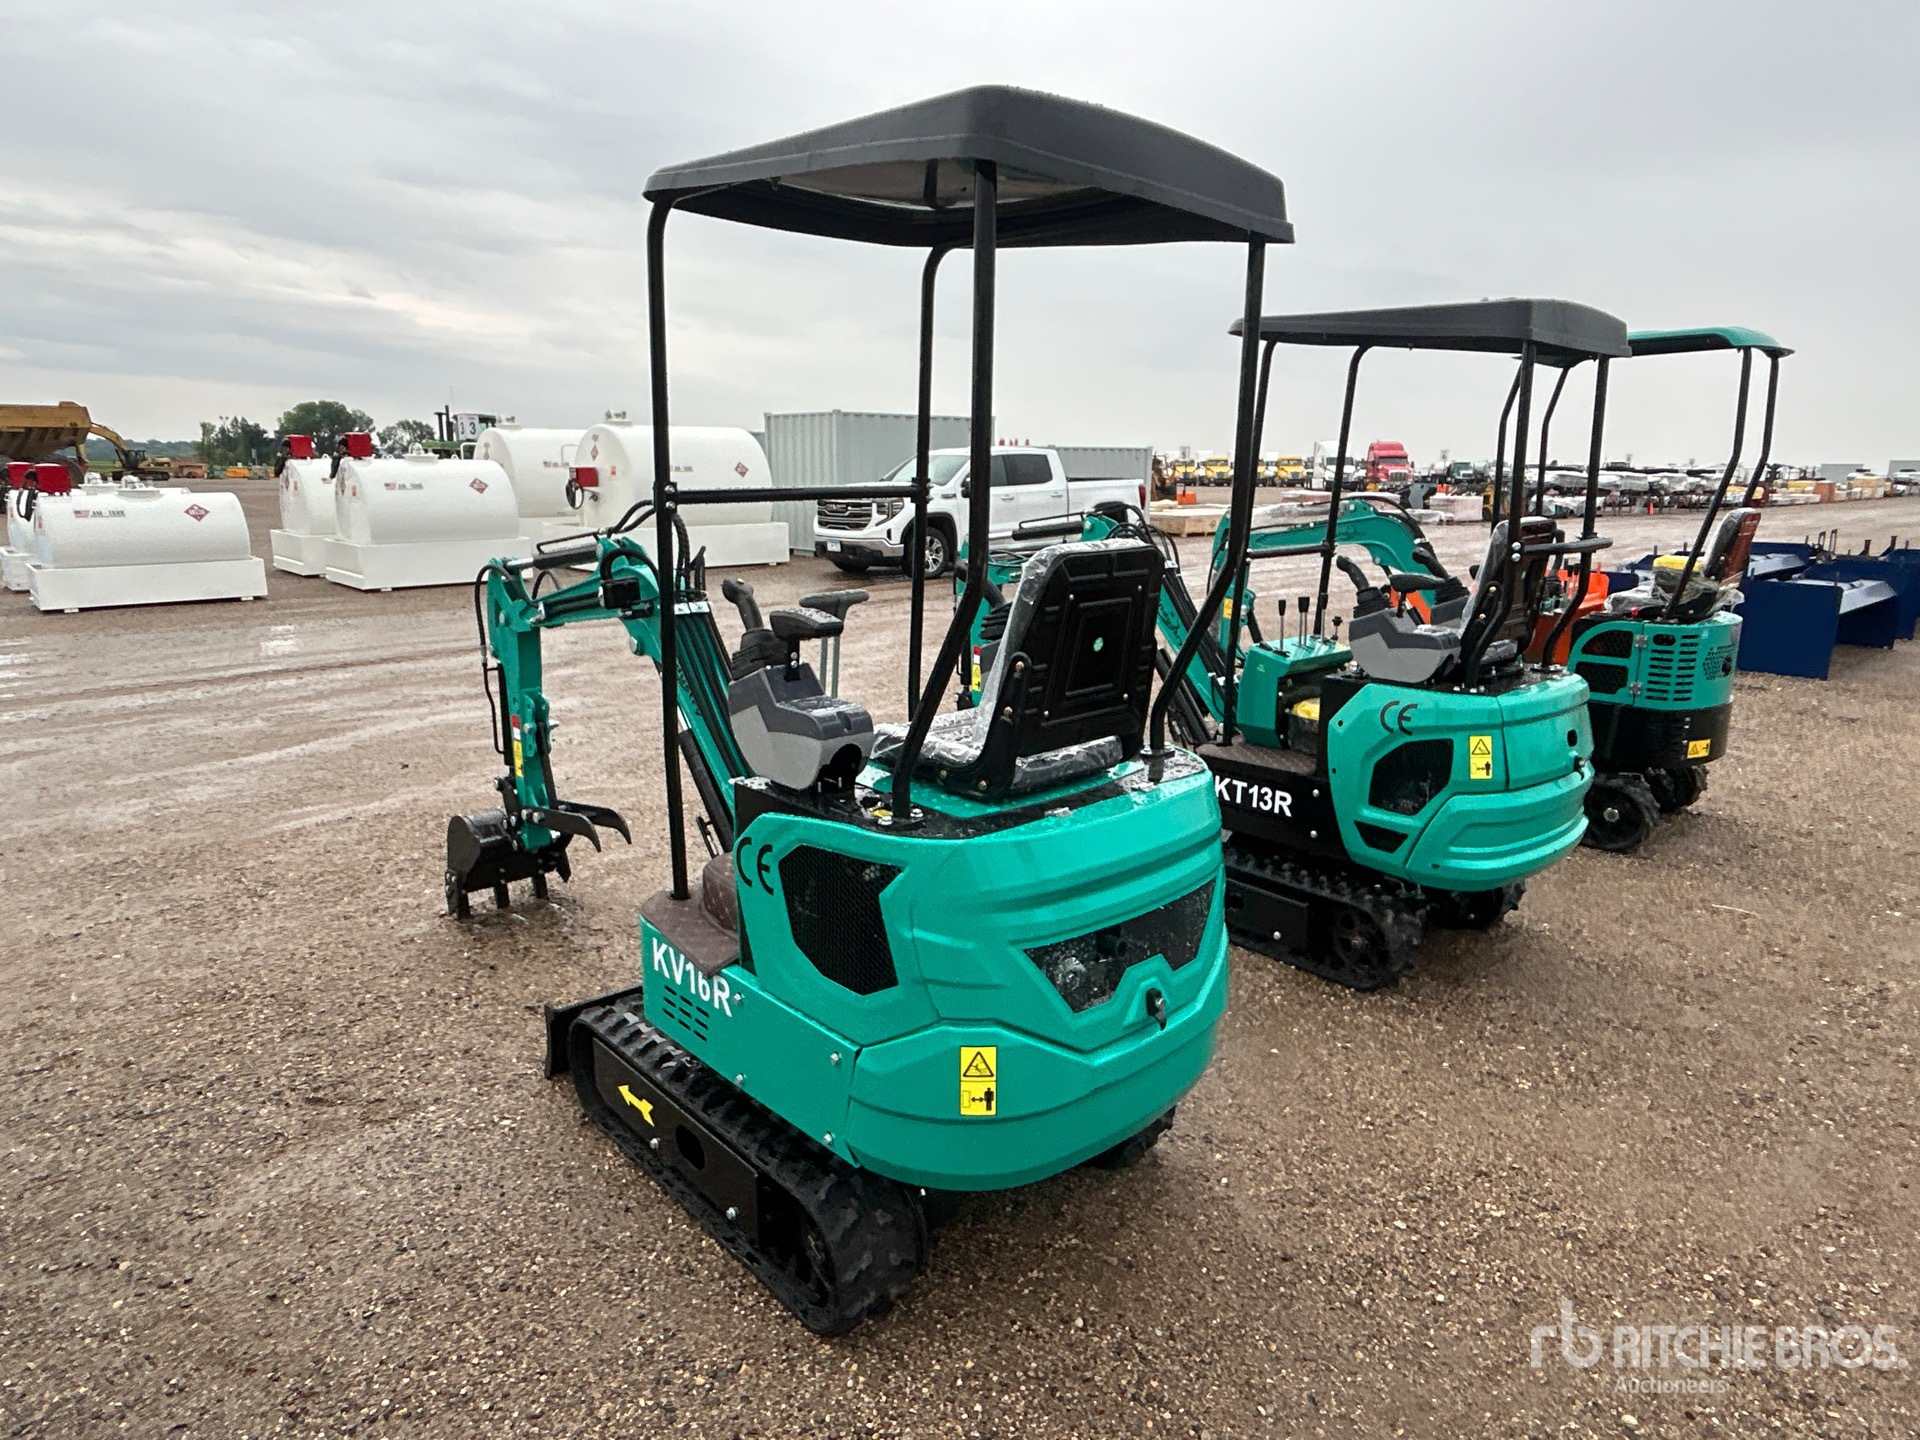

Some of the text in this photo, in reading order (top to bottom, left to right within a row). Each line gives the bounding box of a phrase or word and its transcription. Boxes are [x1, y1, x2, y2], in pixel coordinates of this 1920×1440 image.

[469, 421, 477, 435] 3
[1379, 700, 1418, 735] CE
[1214, 775, 1293, 817] KT13R
[736, 836, 774, 896] CE
[652, 937, 733, 1018] KV16R
